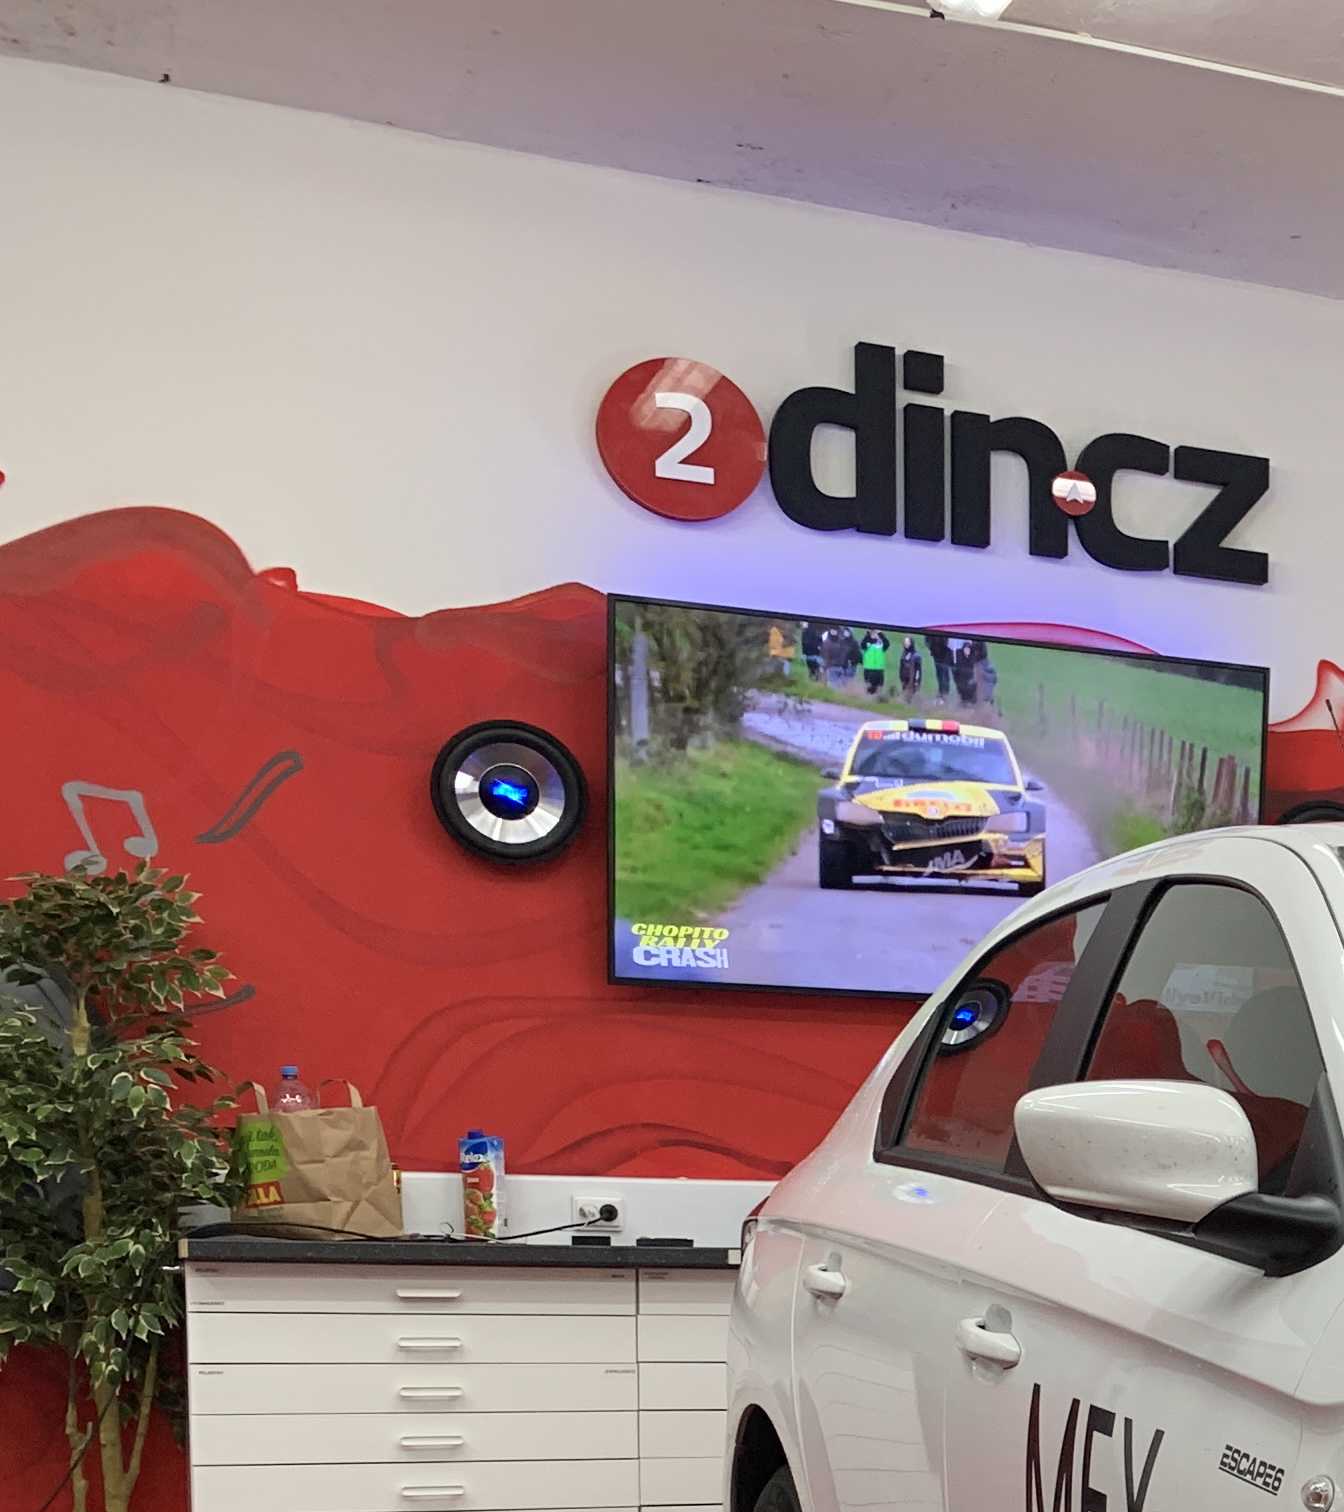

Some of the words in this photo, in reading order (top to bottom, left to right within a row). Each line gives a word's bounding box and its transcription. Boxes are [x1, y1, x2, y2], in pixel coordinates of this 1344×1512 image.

[631, 923, 729, 940] CHOPITO
[632, 945, 729, 968] CRASH
[1219, 1443, 1286, 1492] ESCAPE6
